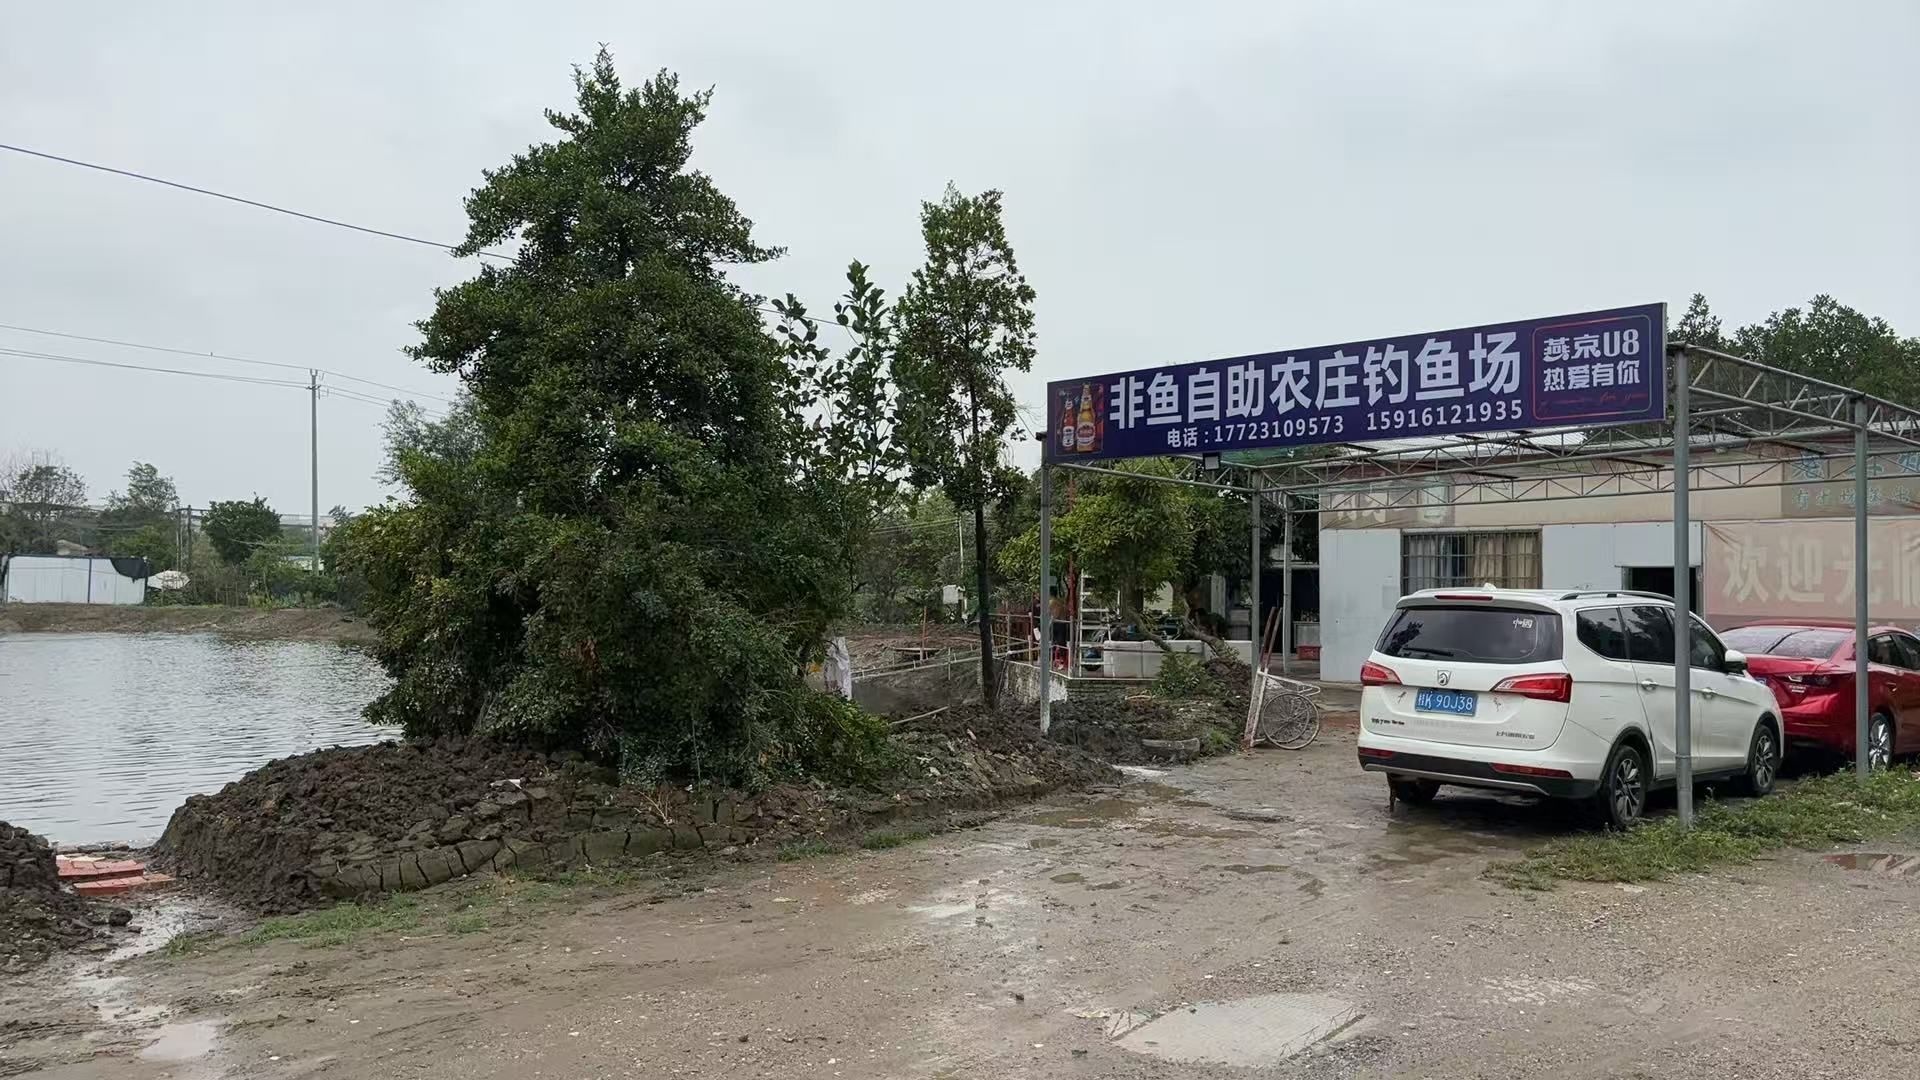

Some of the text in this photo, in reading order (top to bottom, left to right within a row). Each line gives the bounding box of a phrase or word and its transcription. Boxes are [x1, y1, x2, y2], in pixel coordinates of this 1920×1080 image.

[1543, 328, 1640, 362] 燕京U8
[1109, 331, 1521, 430] 非鱼自助农庄钓鱼场
[1543, 359, 1641, 392] 热爱有你
[1367, 399, 1523, 431] 15916121935
